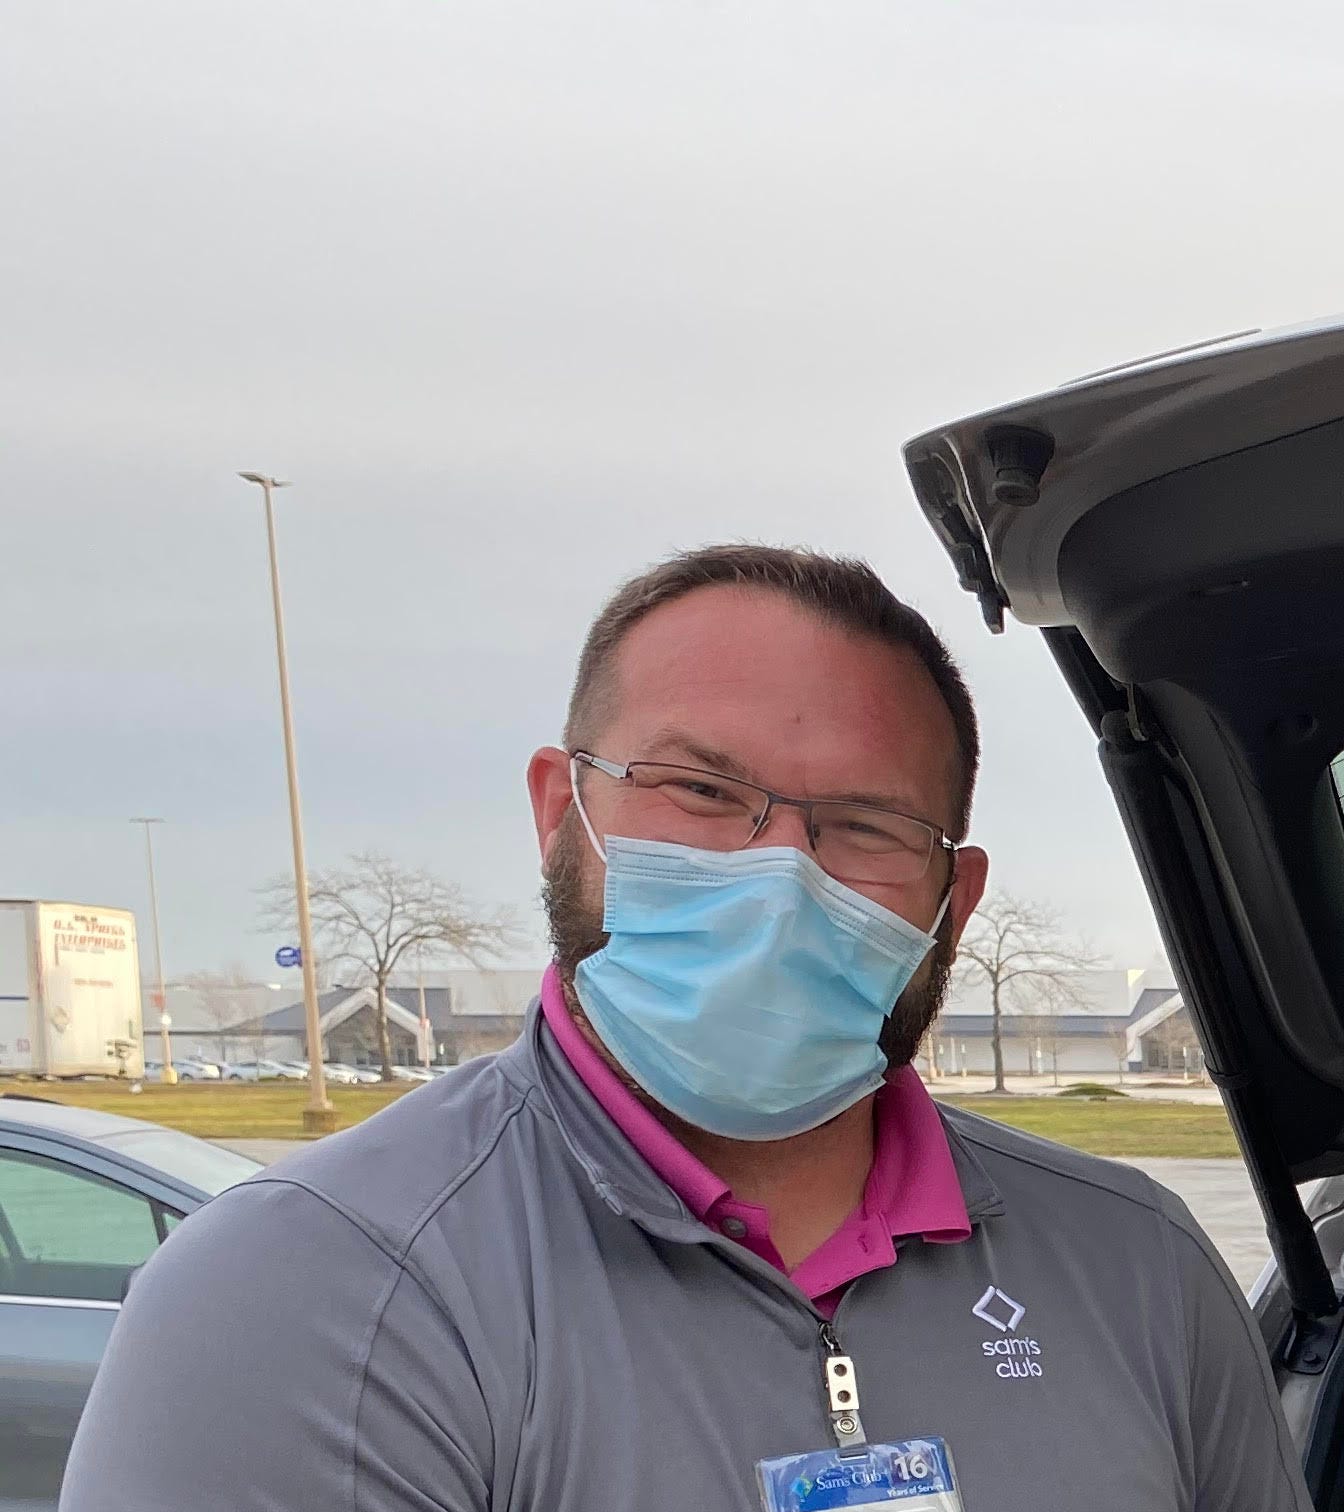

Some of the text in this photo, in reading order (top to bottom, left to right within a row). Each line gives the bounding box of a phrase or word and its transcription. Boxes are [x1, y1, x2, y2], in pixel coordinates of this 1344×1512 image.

[982, 1336, 1041, 1356] sam's
[996, 1357, 1043, 1378] club
[852, 1469, 882, 1486] Club
[894, 1455, 928, 1481] 16
